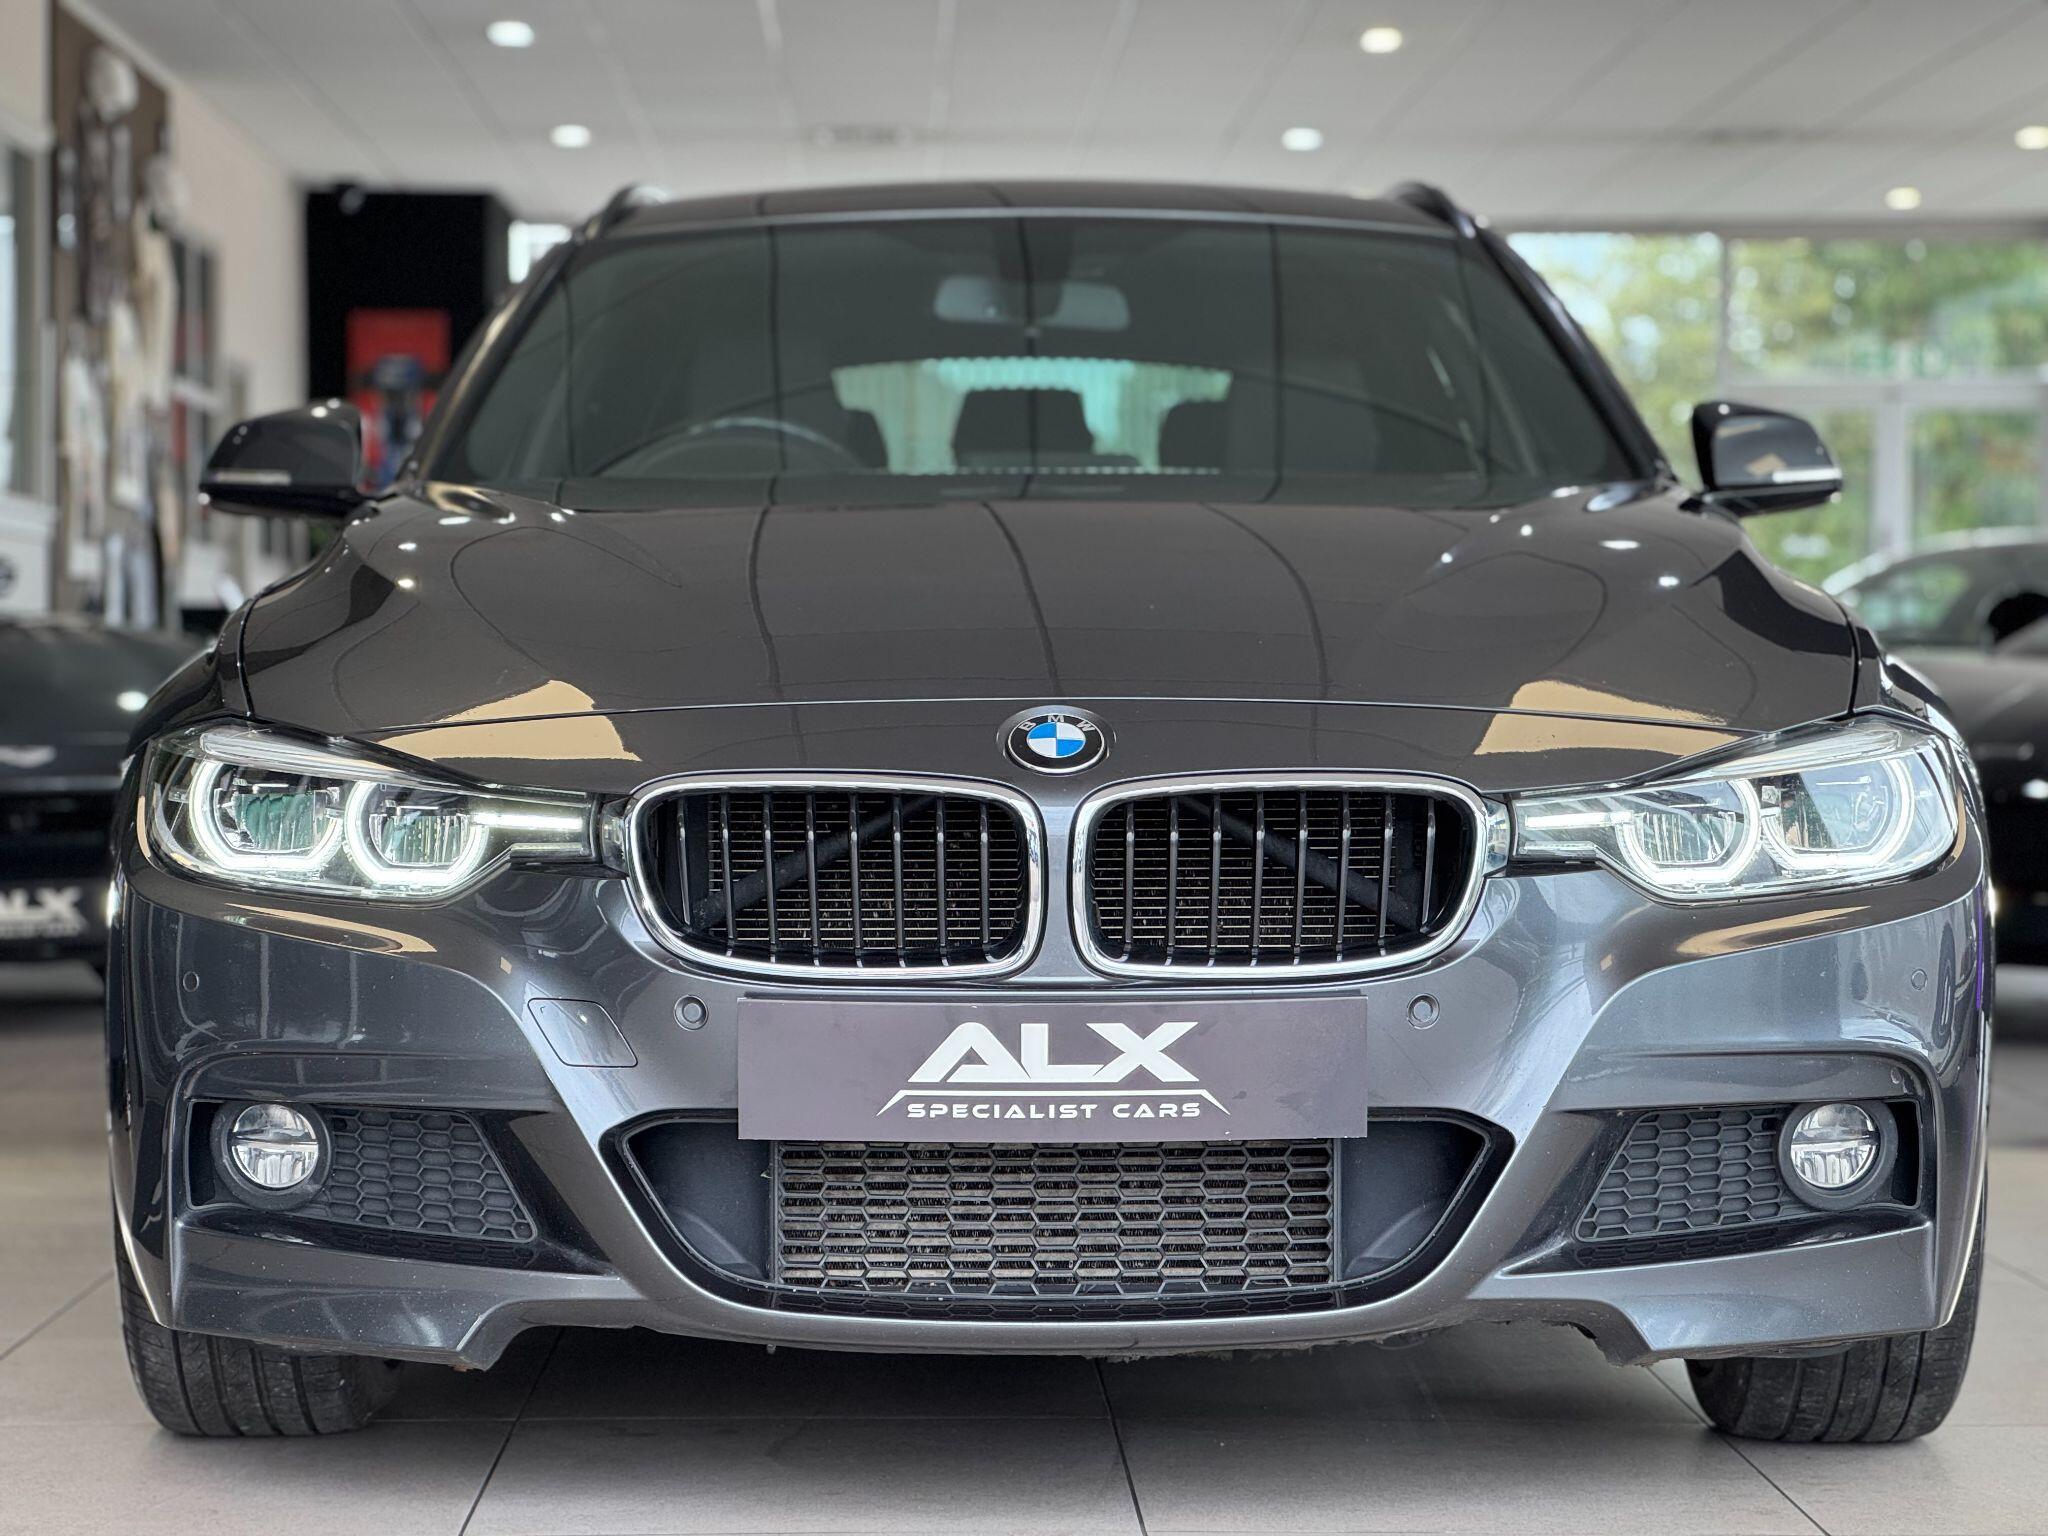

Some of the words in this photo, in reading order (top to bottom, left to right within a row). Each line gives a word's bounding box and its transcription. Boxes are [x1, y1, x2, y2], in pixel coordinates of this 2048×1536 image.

[1017, 714, 1096, 732] BMW
[0, 887, 83, 922] LX
[906, 1021, 1201, 1084] ALX
[906, 1102, 1099, 1120] SPECIALIST
[1111, 1102, 1202, 1120] CARS
